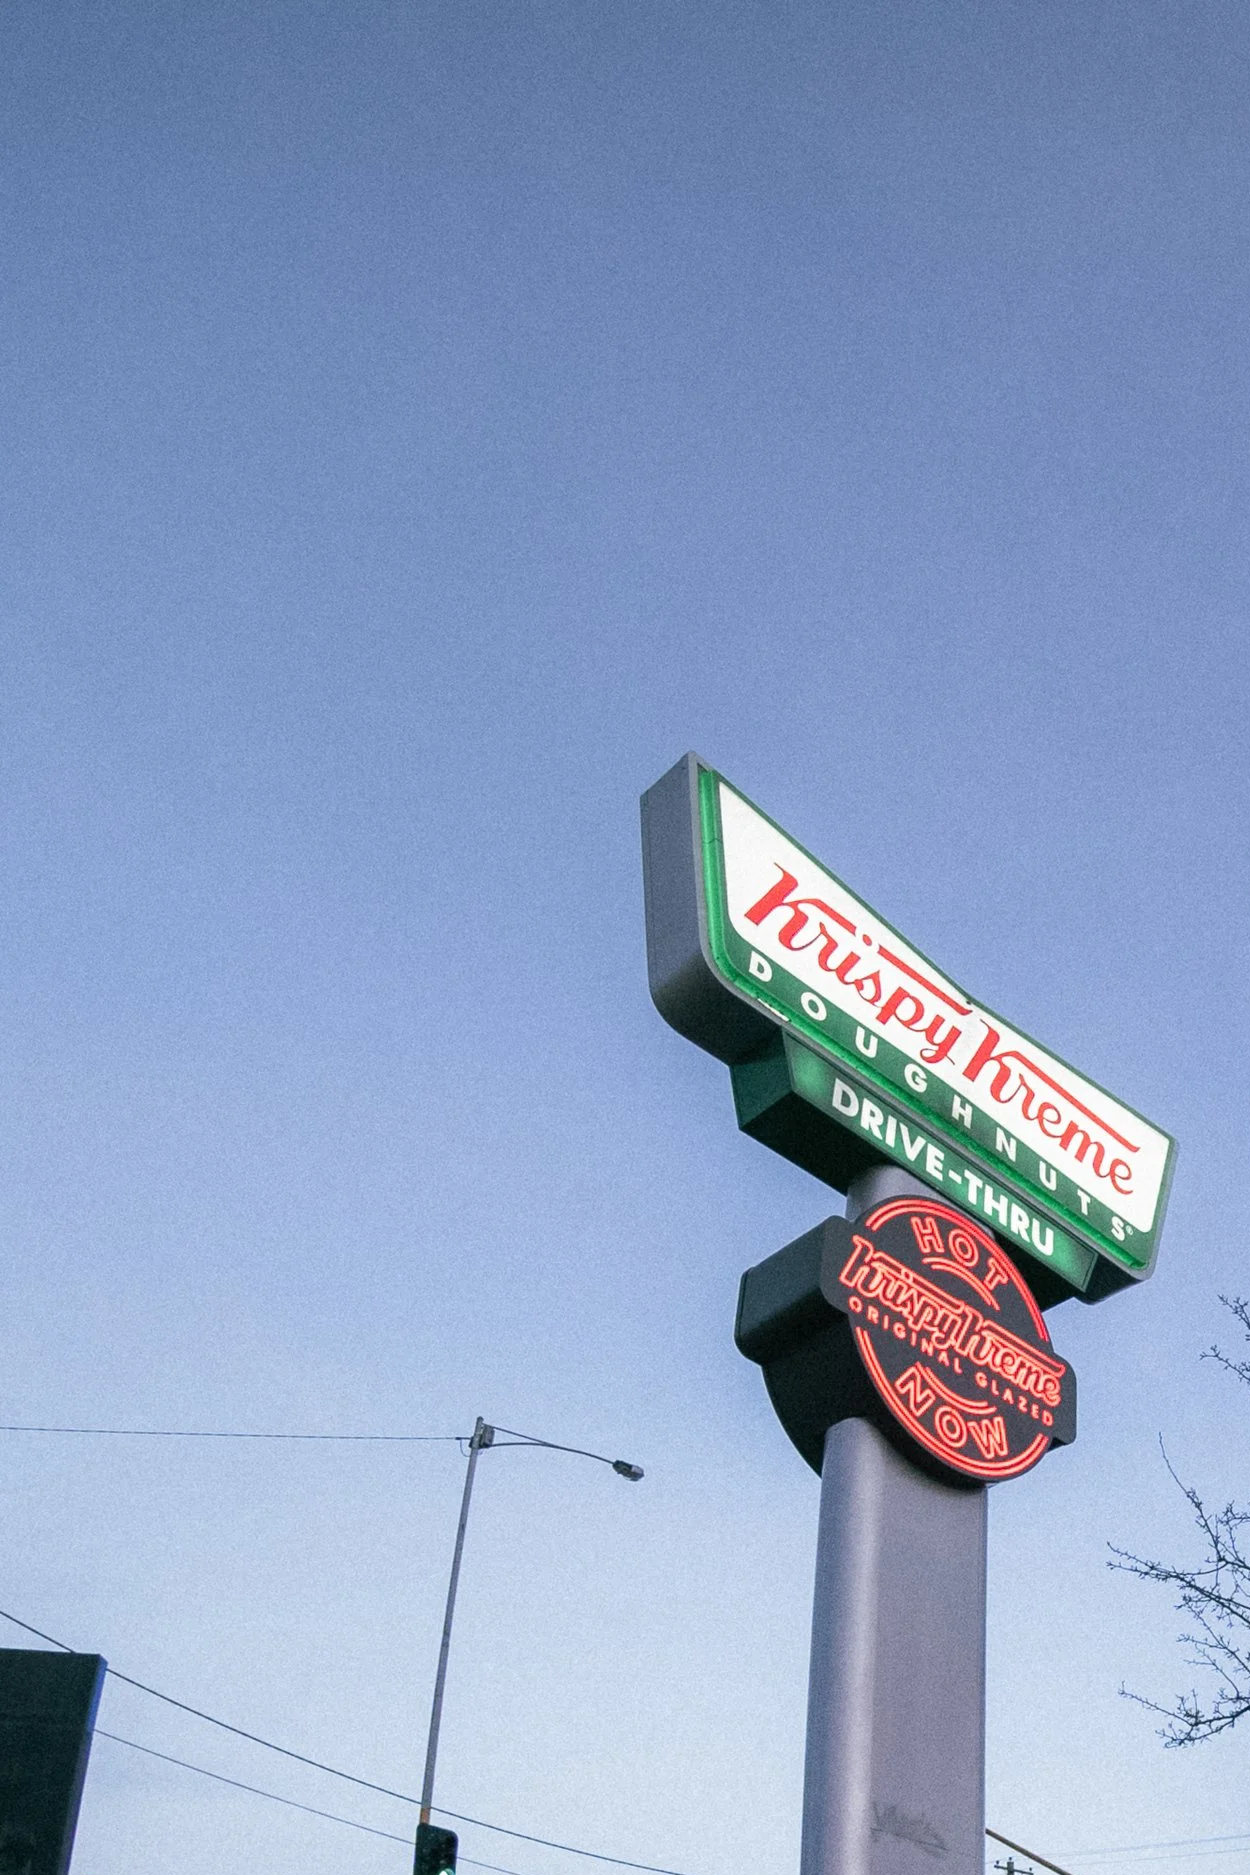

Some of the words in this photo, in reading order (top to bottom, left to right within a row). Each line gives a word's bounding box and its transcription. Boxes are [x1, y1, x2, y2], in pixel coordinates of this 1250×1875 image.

[743, 861, 973, 1066] Krispy
[963, 1019, 1141, 1195] Kreme
[832, 1077, 1054, 1257] DRIVE-THRU
[839, 1234, 965, 1349] Krispy
[955, 1305, 1066, 1407] Kreme
[911, 1216, 1008, 1291] HOT
[849, 1296, 963, 1374] ORIGINAL
[974, 1371, 1054, 1427] GLAZED
[895, 1365, 1008, 1459] NOW
